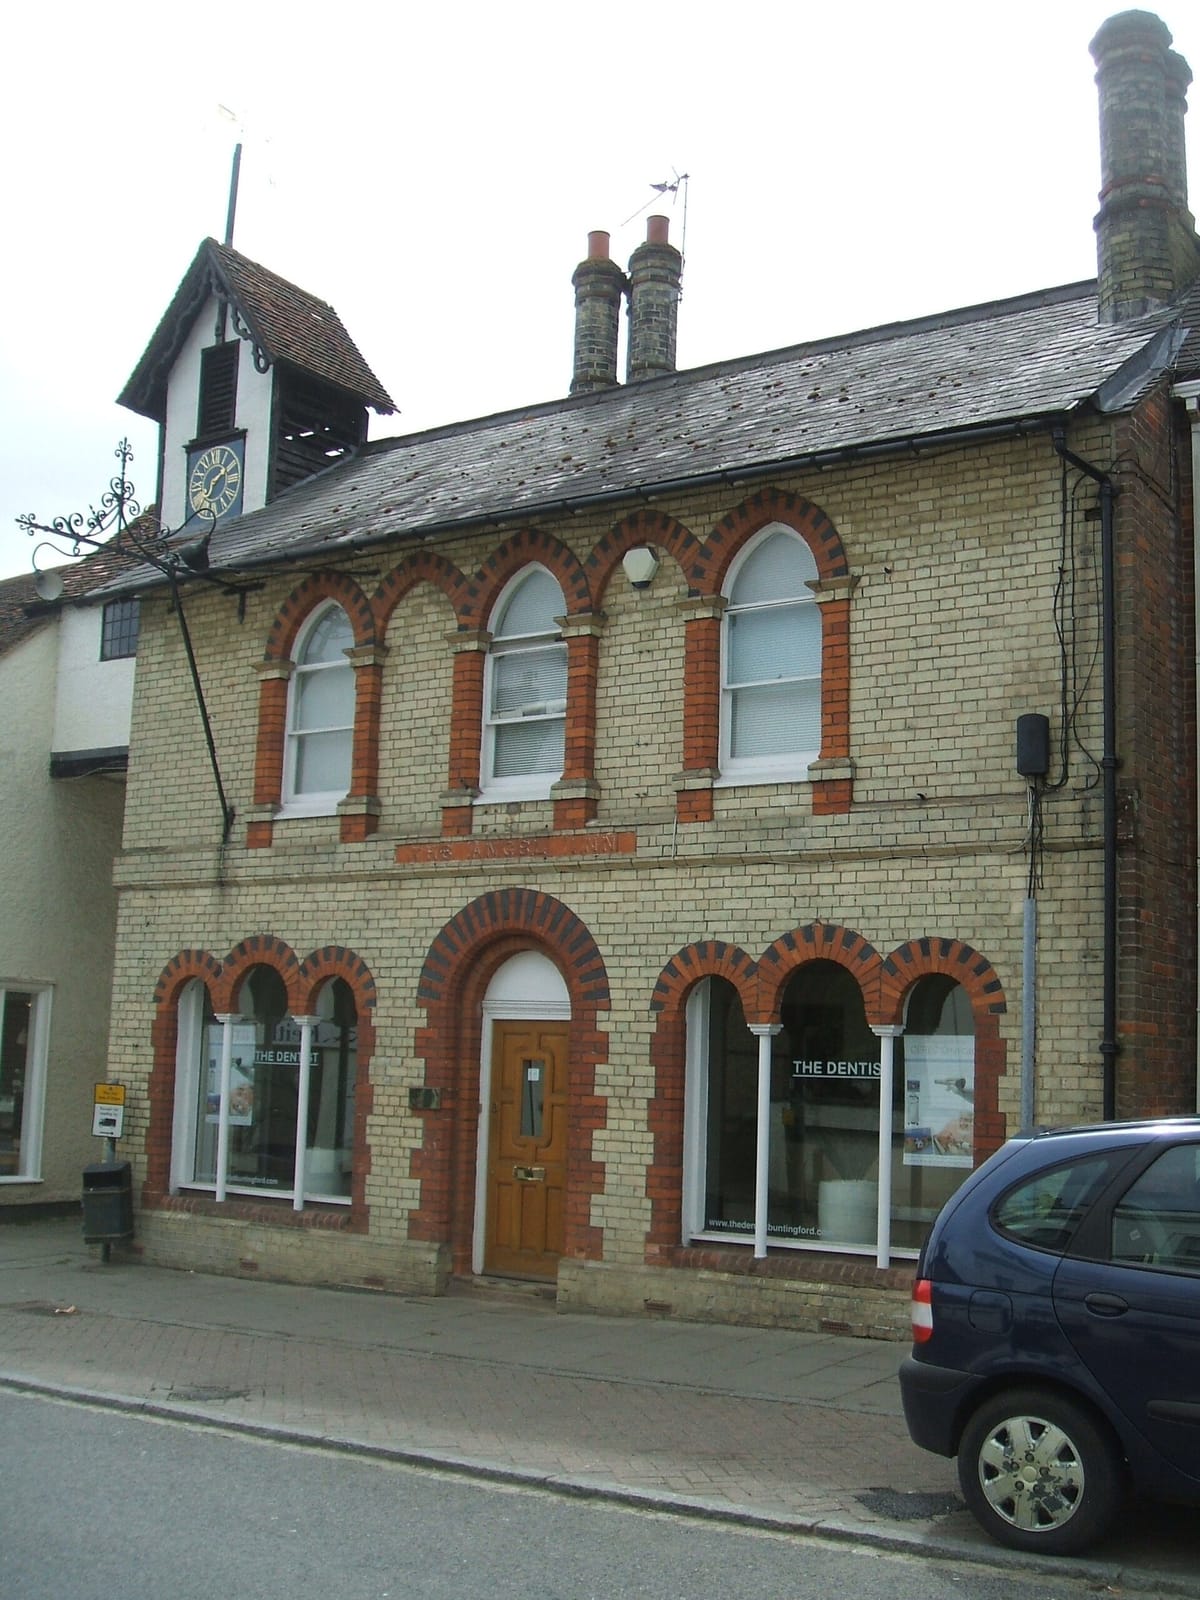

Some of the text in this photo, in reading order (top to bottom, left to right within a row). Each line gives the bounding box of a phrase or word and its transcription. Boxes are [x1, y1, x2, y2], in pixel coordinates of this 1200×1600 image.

[255, 1050, 319, 1064] THE DENTST
[792, 1060, 882, 1076] THE DENTIS
